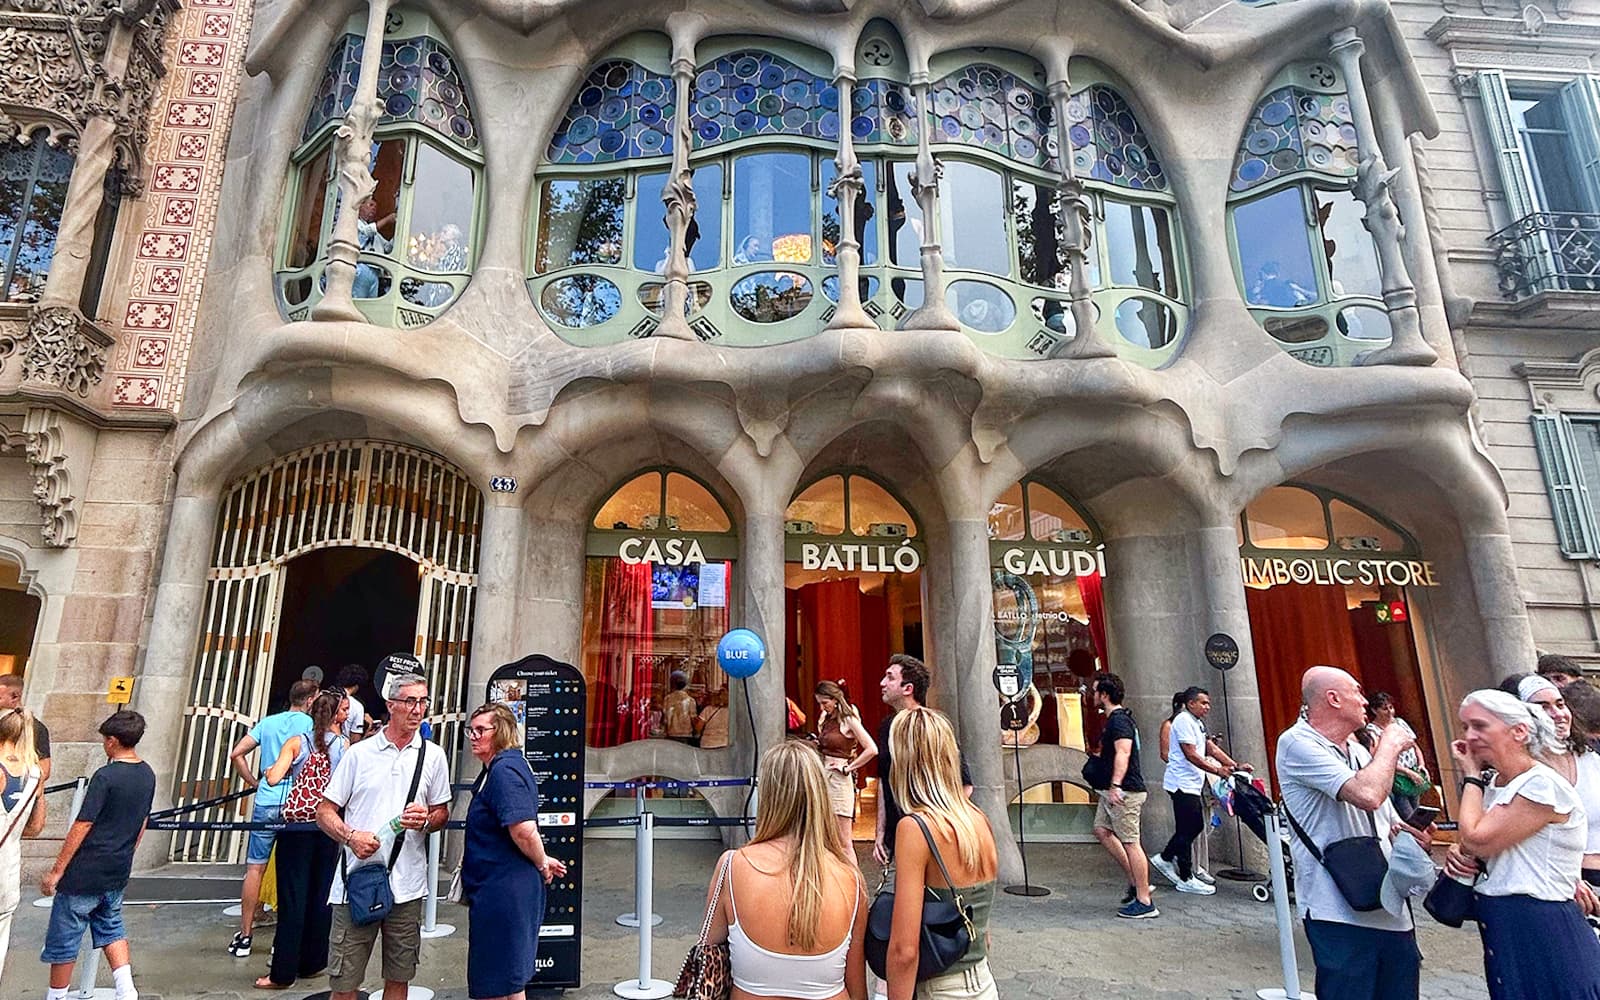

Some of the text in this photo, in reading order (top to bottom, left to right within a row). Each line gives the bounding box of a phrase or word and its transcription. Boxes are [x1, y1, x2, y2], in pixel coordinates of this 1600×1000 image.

[494, 478, 512, 490] 43
[619, 538, 707, 565] CASA
[802, 538, 920, 573] BATLLÓ
[1003, 543, 1107, 577] GAUDÍ
[1240, 558, 1440, 586] IMBOLIC STORE
[725, 650, 749, 659] BLUE
[392, 662, 414, 672] ONLINE
[535, 956, 554, 968] TLLÓ
